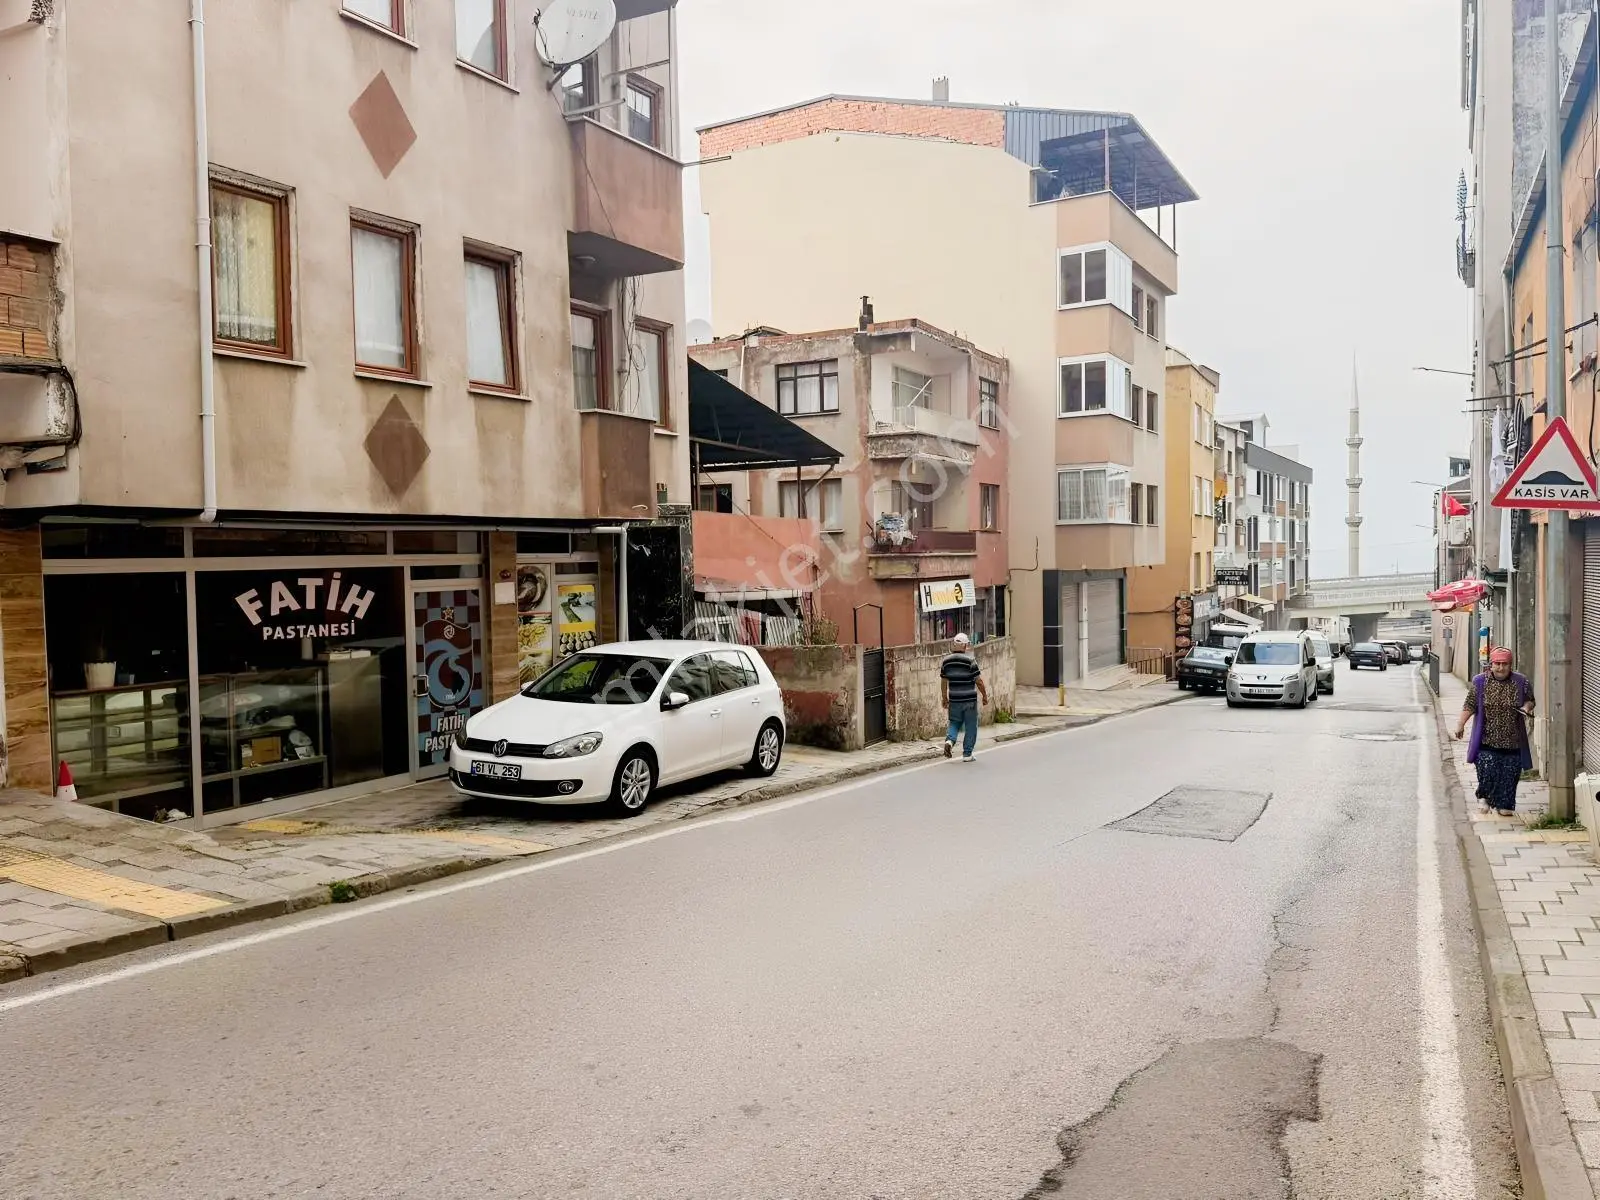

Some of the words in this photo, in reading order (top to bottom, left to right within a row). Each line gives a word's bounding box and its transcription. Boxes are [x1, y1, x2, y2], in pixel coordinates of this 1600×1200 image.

[1514, 486, 1556, 498] KASİS
[1560, 489, 1589, 499] VAR
[235, 571, 376, 626] FATİH
[262, 619, 356, 641] PASTANESİ
[437, 712, 465, 733] FATİH
[425, 733, 457, 753] PASTA
[476, 762, 485, 773] 61
[488, 764, 498, 775] VL
[502, 766, 520, 778] 253
